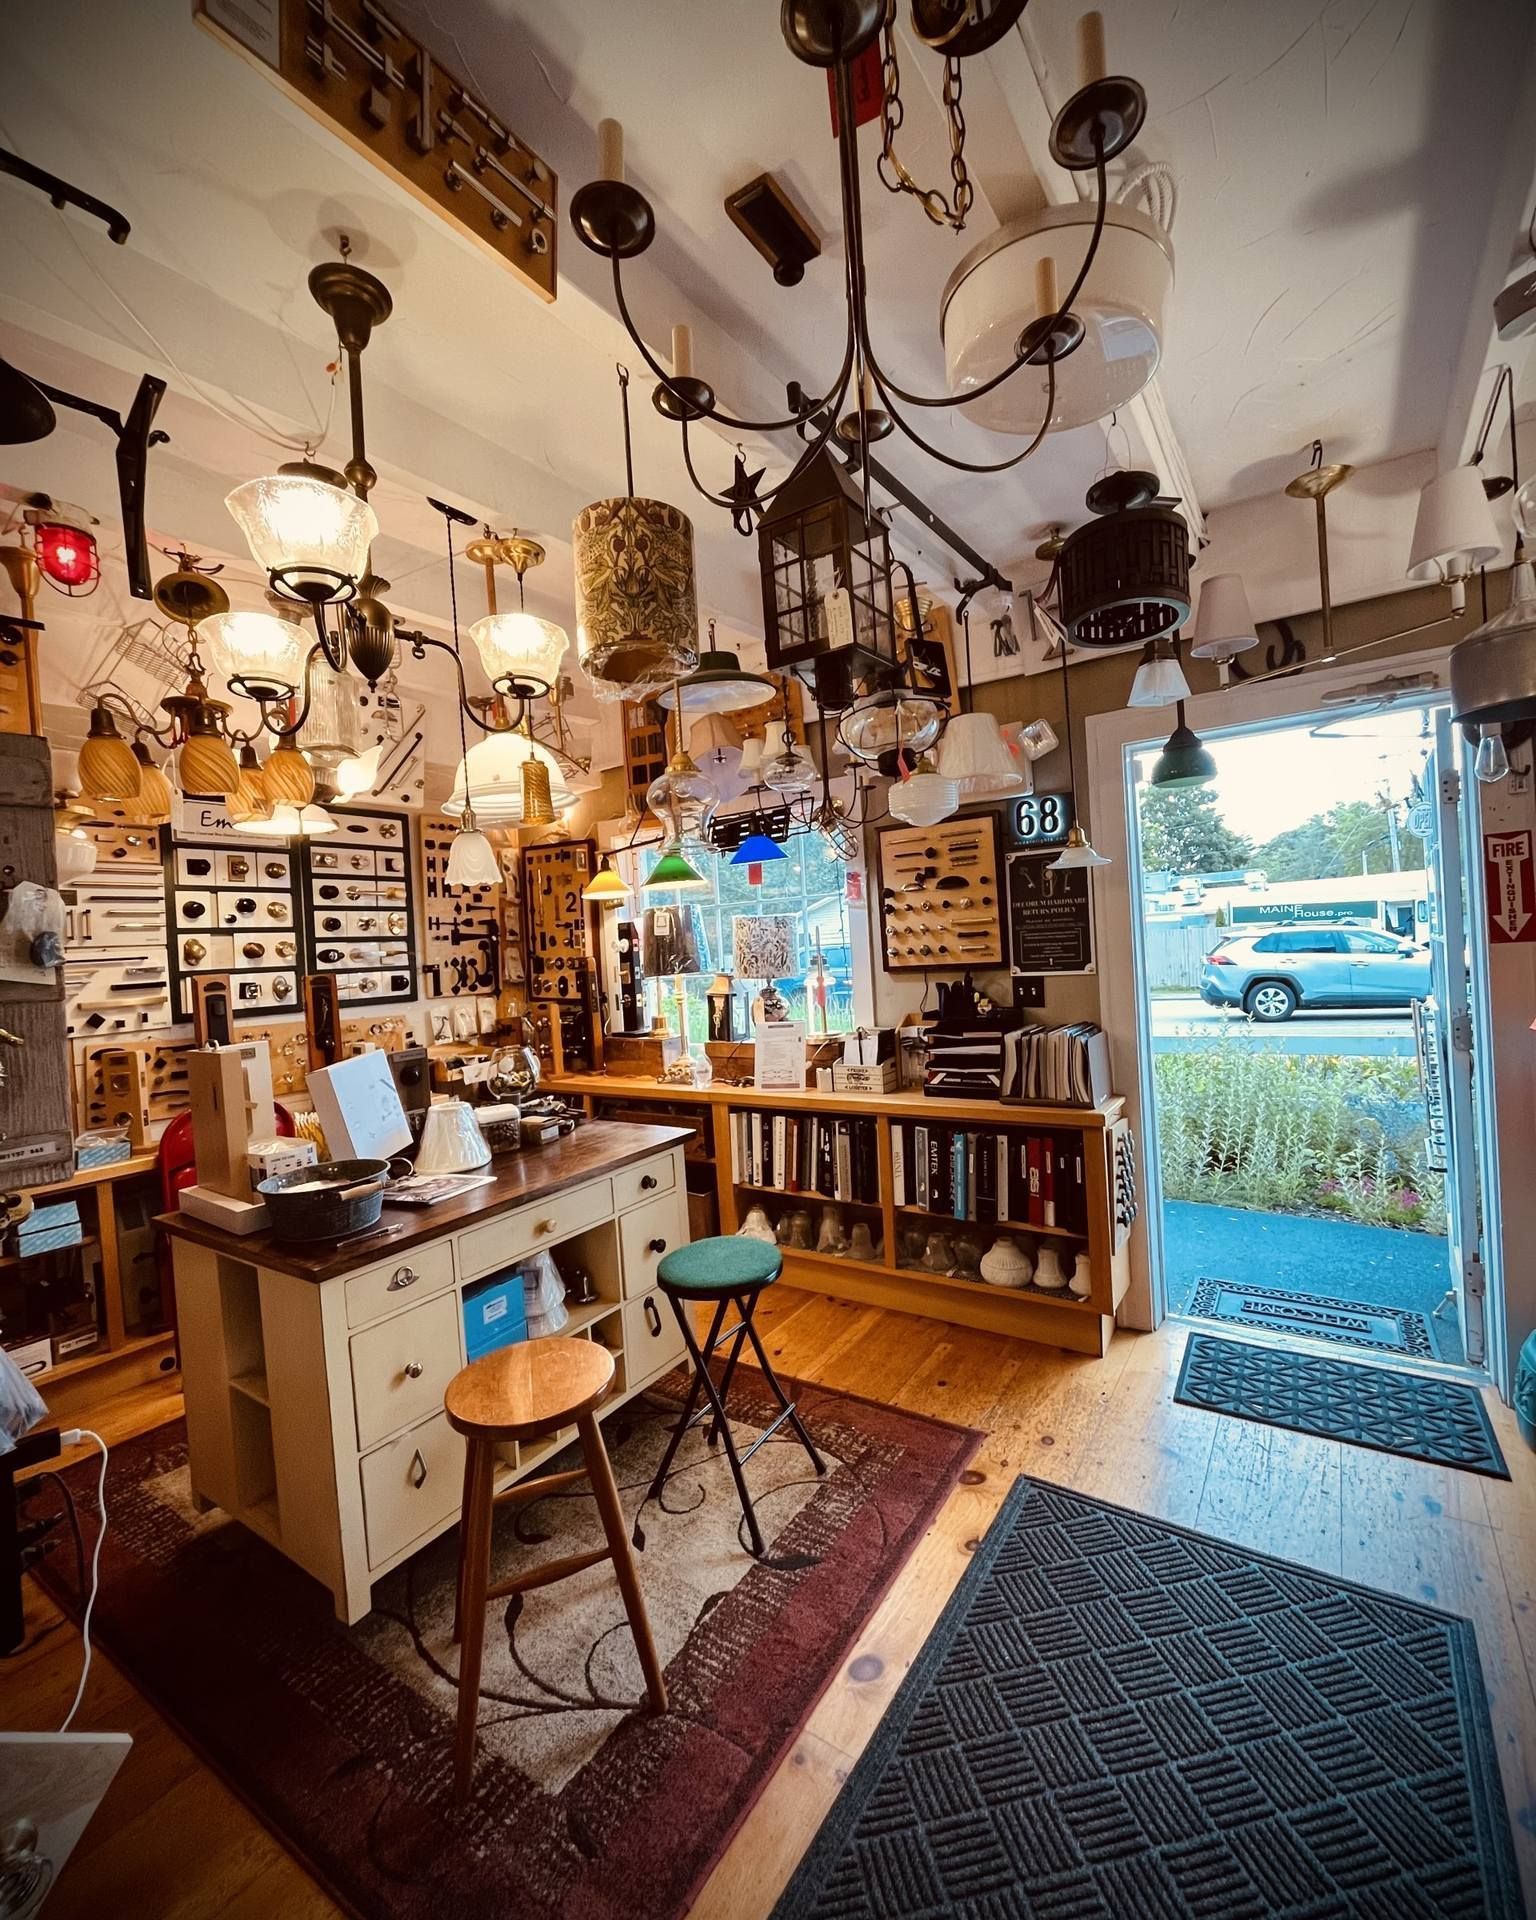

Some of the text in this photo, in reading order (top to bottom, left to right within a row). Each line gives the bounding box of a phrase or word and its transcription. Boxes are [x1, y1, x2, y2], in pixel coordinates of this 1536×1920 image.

[1016, 797, 1060, 836] 68
[1414, 813, 1432, 829] OPE
[1492, 841, 1525, 859] FIRE
[1505, 859, 1518, 932] EXTINGUISHER
[1051, 907, 1076, 915] POLICY
[1259, 904, 1303, 914] MAINE
[930, 1140, 938, 1175] EMTEK
[1243, 1301, 1368, 1329] WELCOME
